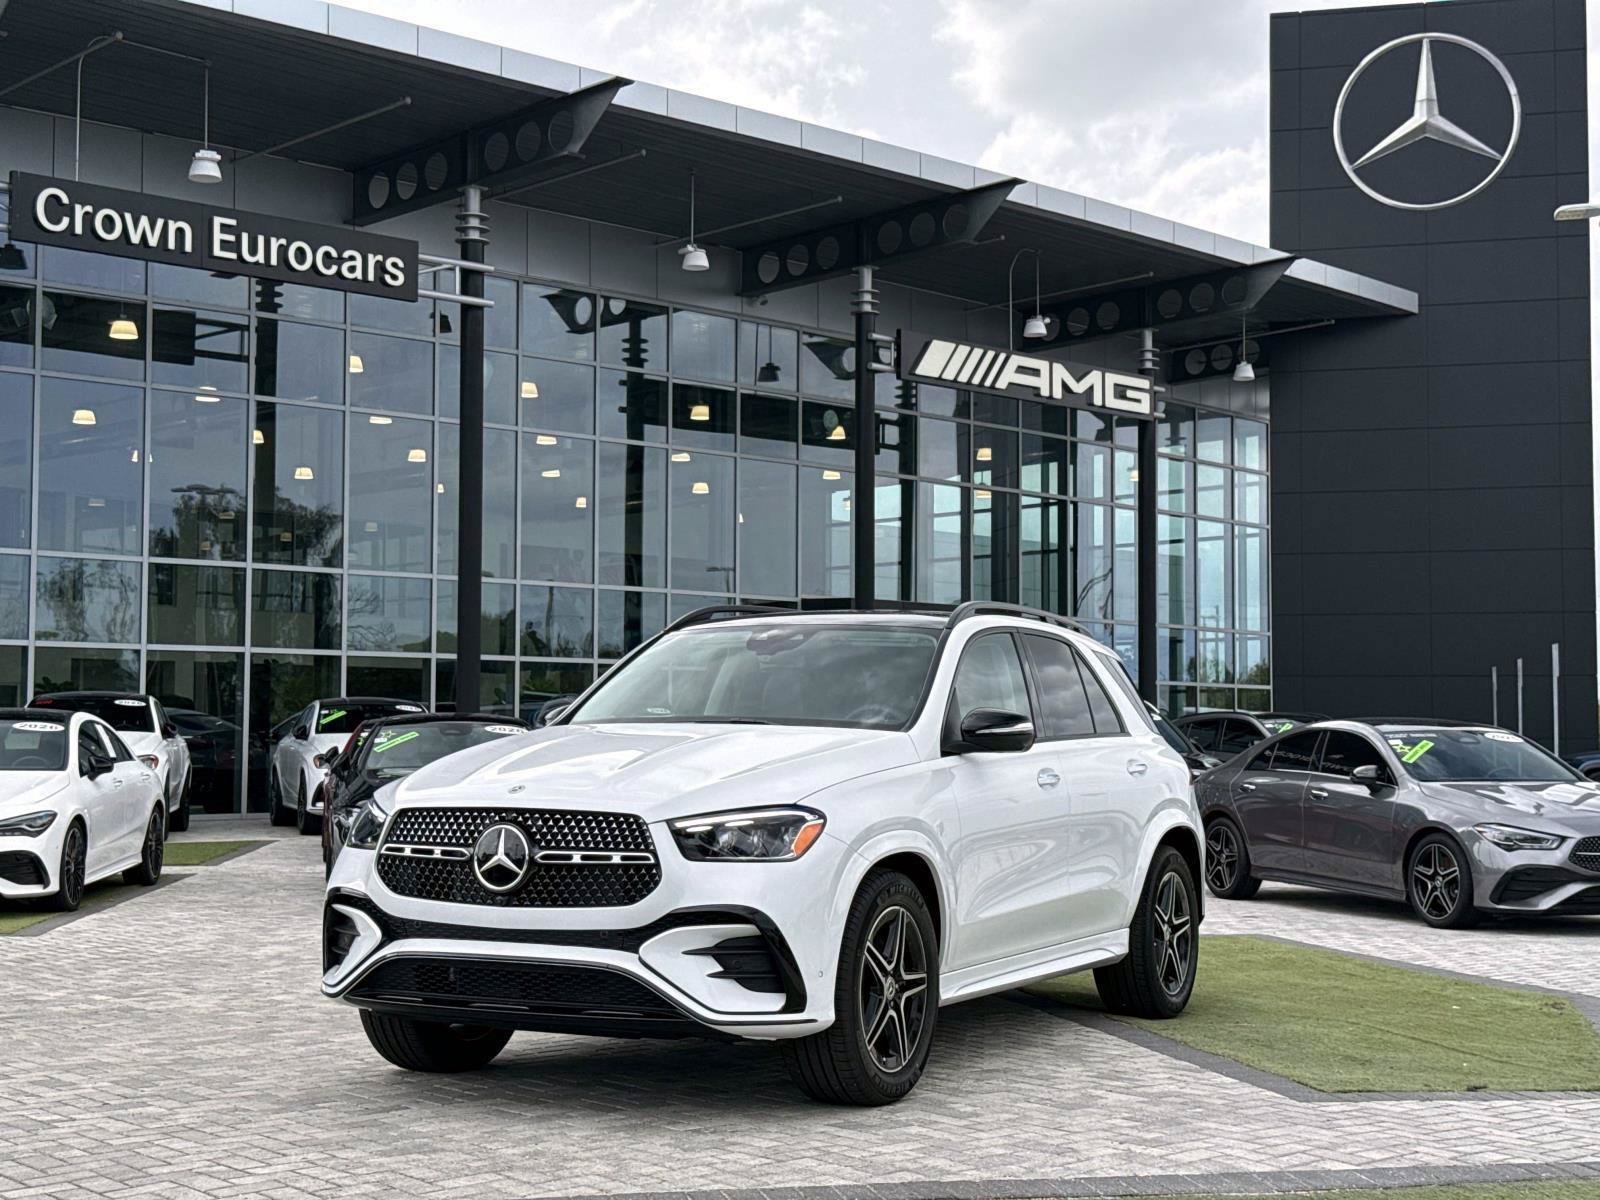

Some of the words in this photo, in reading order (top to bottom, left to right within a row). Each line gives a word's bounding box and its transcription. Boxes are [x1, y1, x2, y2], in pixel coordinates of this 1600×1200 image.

[34, 187, 193, 253] Crown
[211, 215, 406, 287] Eurocars
[995, 354, 1150, 414] AMG
